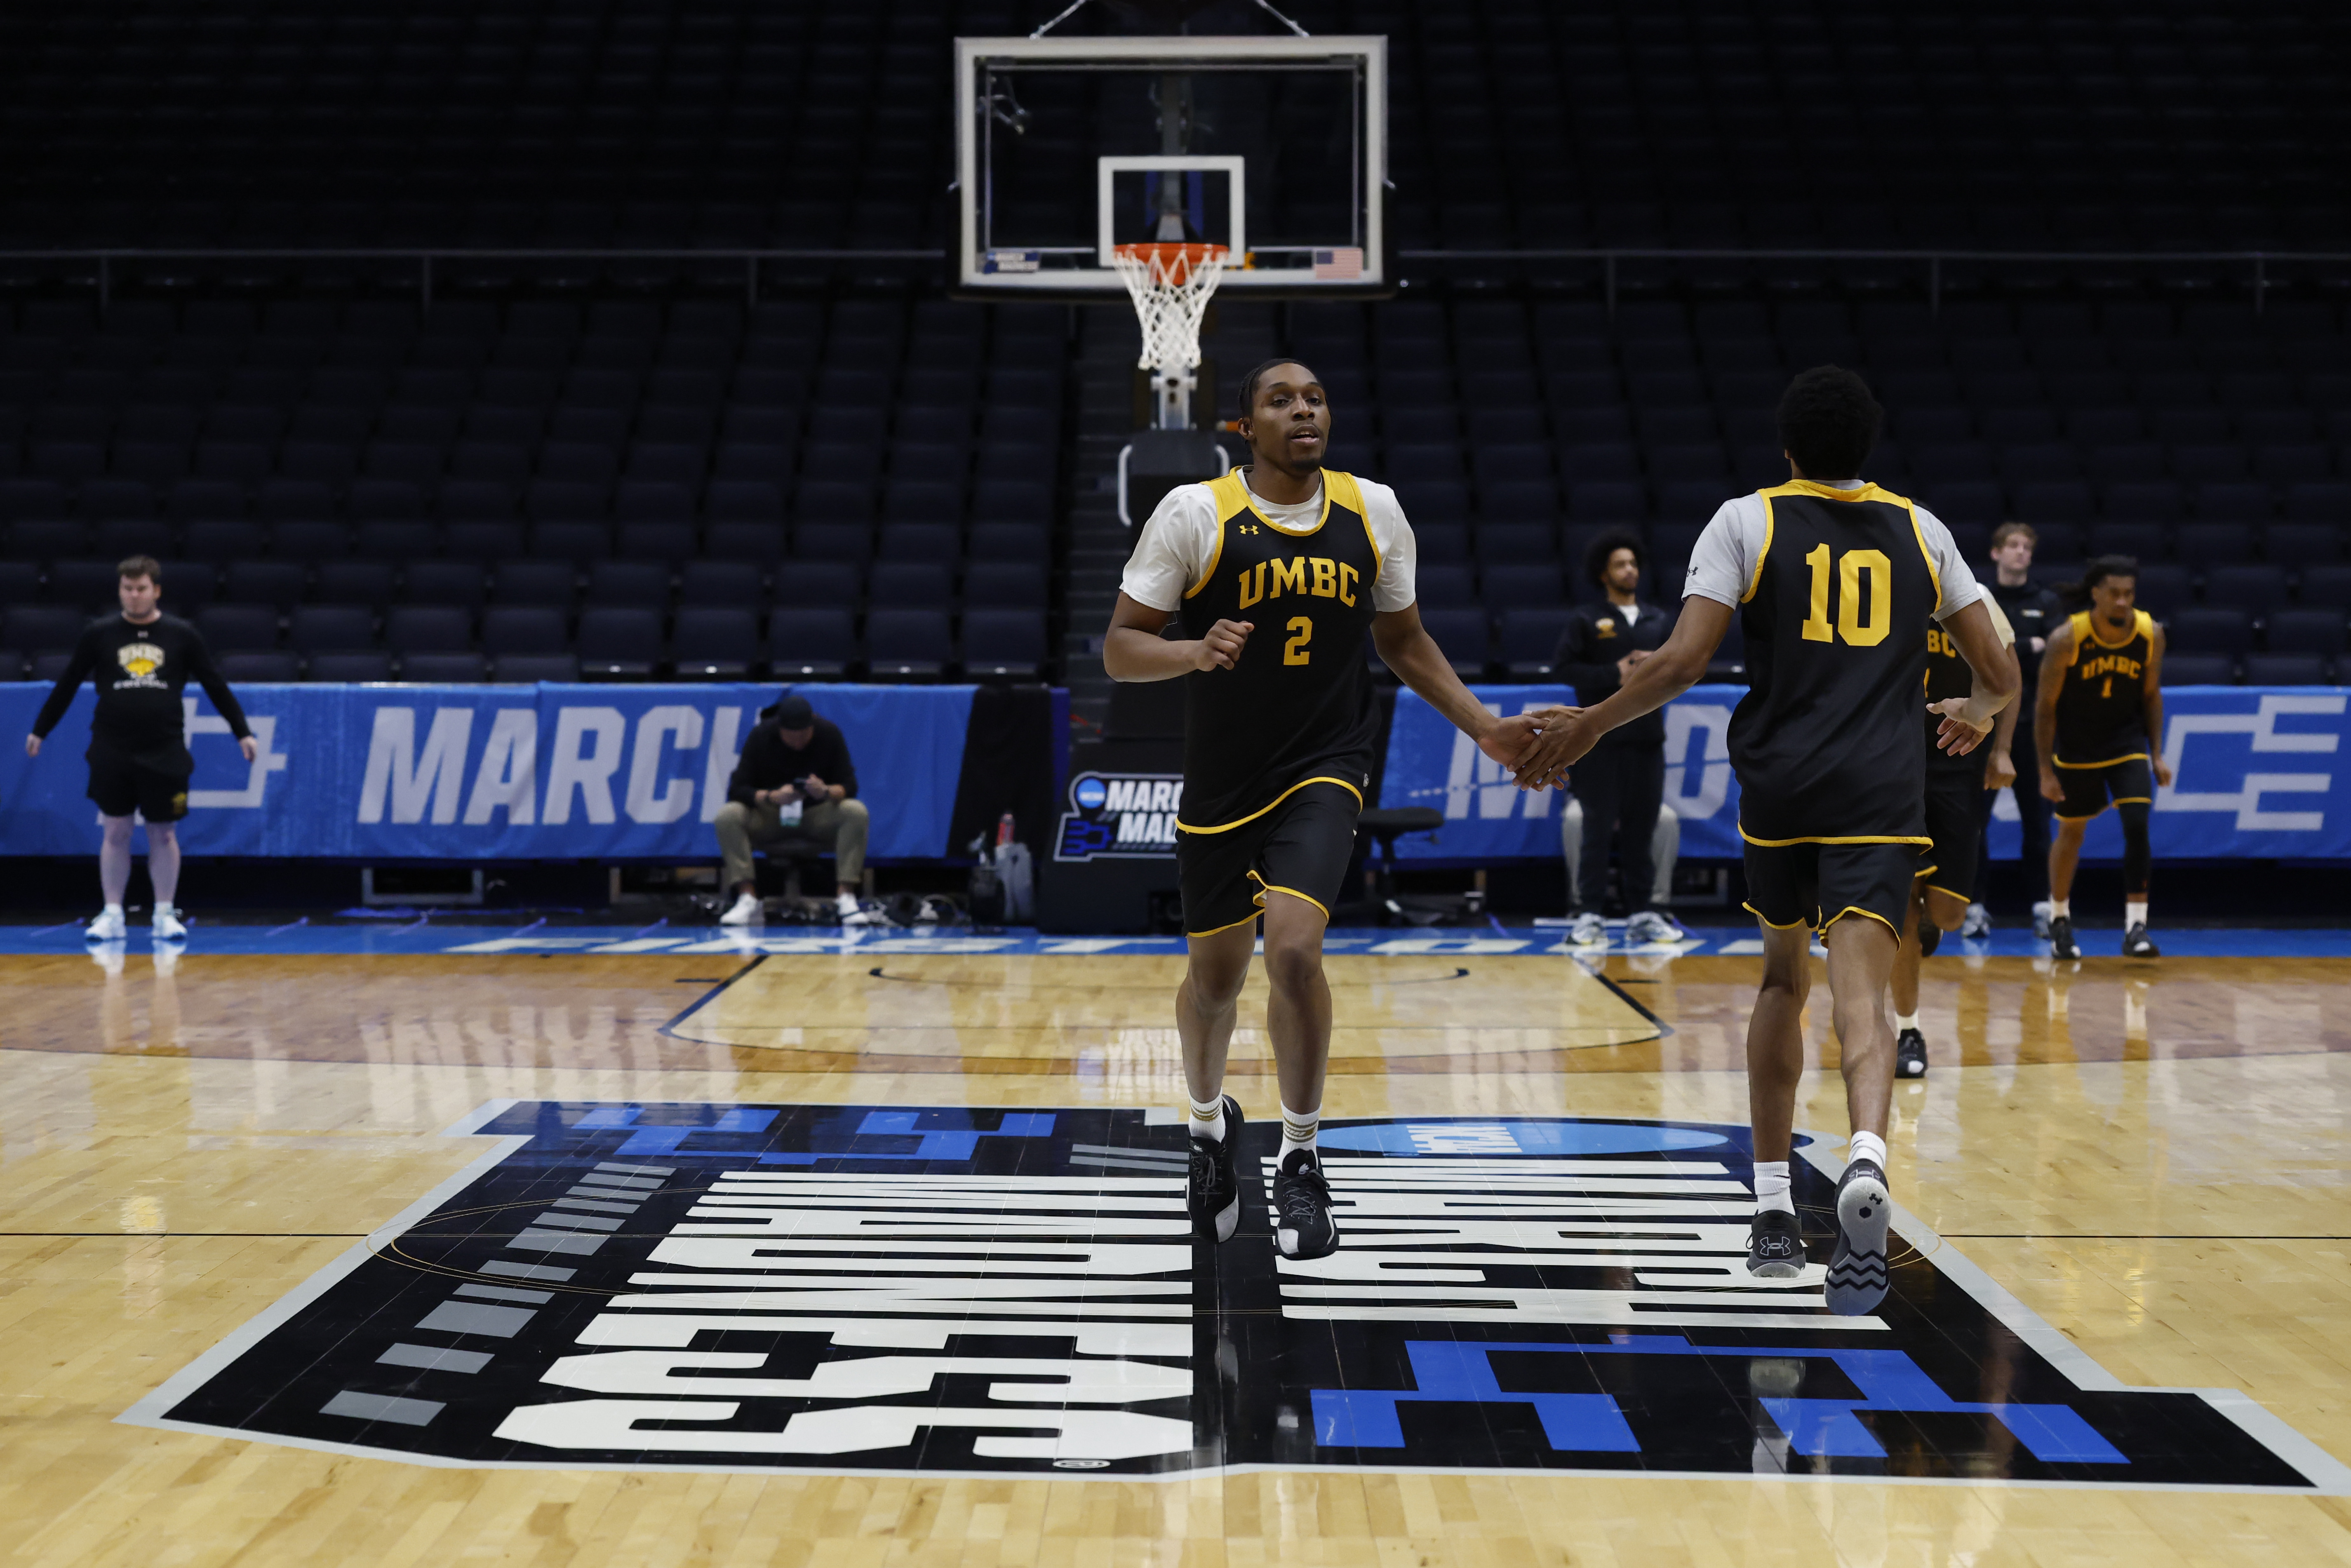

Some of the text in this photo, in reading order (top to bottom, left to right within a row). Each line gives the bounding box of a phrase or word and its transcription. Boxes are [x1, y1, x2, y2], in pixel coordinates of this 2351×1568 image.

[1239, 556, 1359, 610] UMBC
[1802, 543, 1891, 646] 10
[1283, 616, 1313, 665] 2
[1927, 629, 1956, 658] BC
[1105, 780, 1184, 812] MARC
[1406, 1125, 1523, 1154] NCAA
[1260, 1157, 1892, 1330] MARCH
[492, 1170, 1192, 1458] MADNESS
